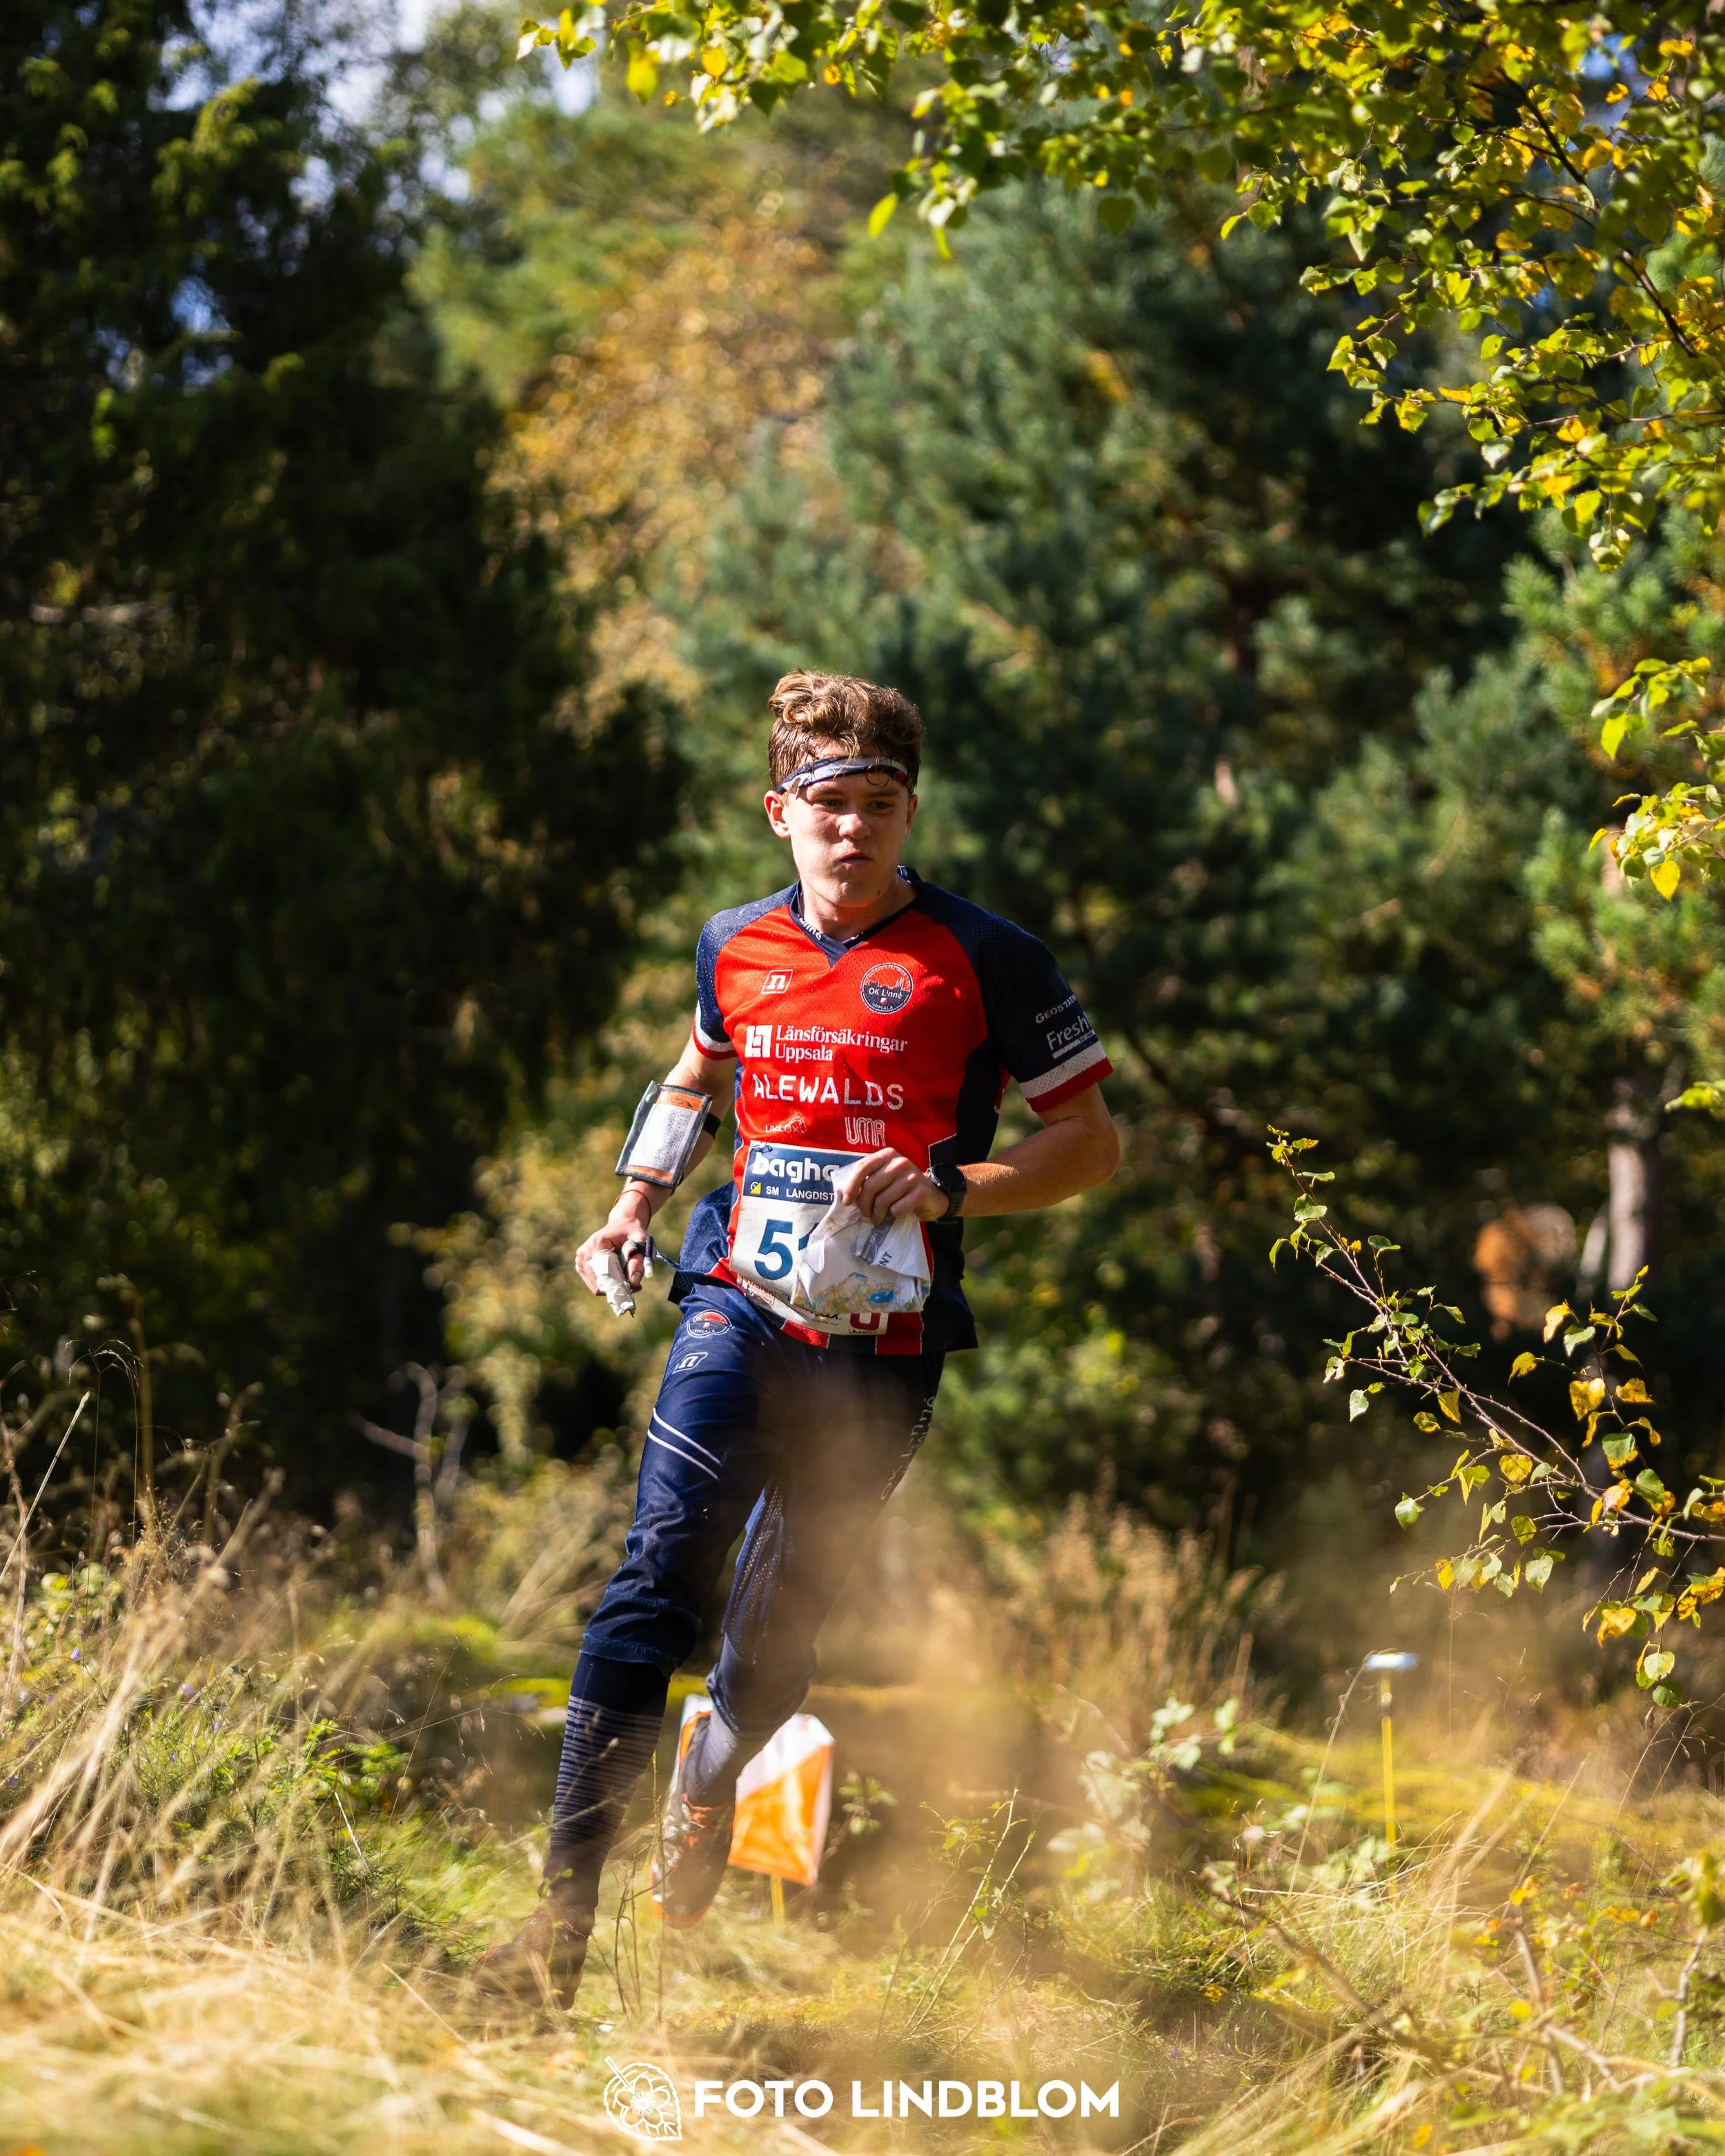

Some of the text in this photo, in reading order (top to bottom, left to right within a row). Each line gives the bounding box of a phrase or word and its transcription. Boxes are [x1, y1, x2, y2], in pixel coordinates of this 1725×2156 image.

[871, 1002, 894, 1010] UPPSALA
[881, 989, 903, 999] Linné
[776, 1025, 908, 1053] Länsförsäkringar
[1046, 1011, 1092, 1050] Fresh
[775, 1042, 834, 1063] Uppsala
[752, 1074, 904, 1110] ALEWALDS
[766, 1185, 780, 1196] SM
[880, 1465, 903, 1501] OK
